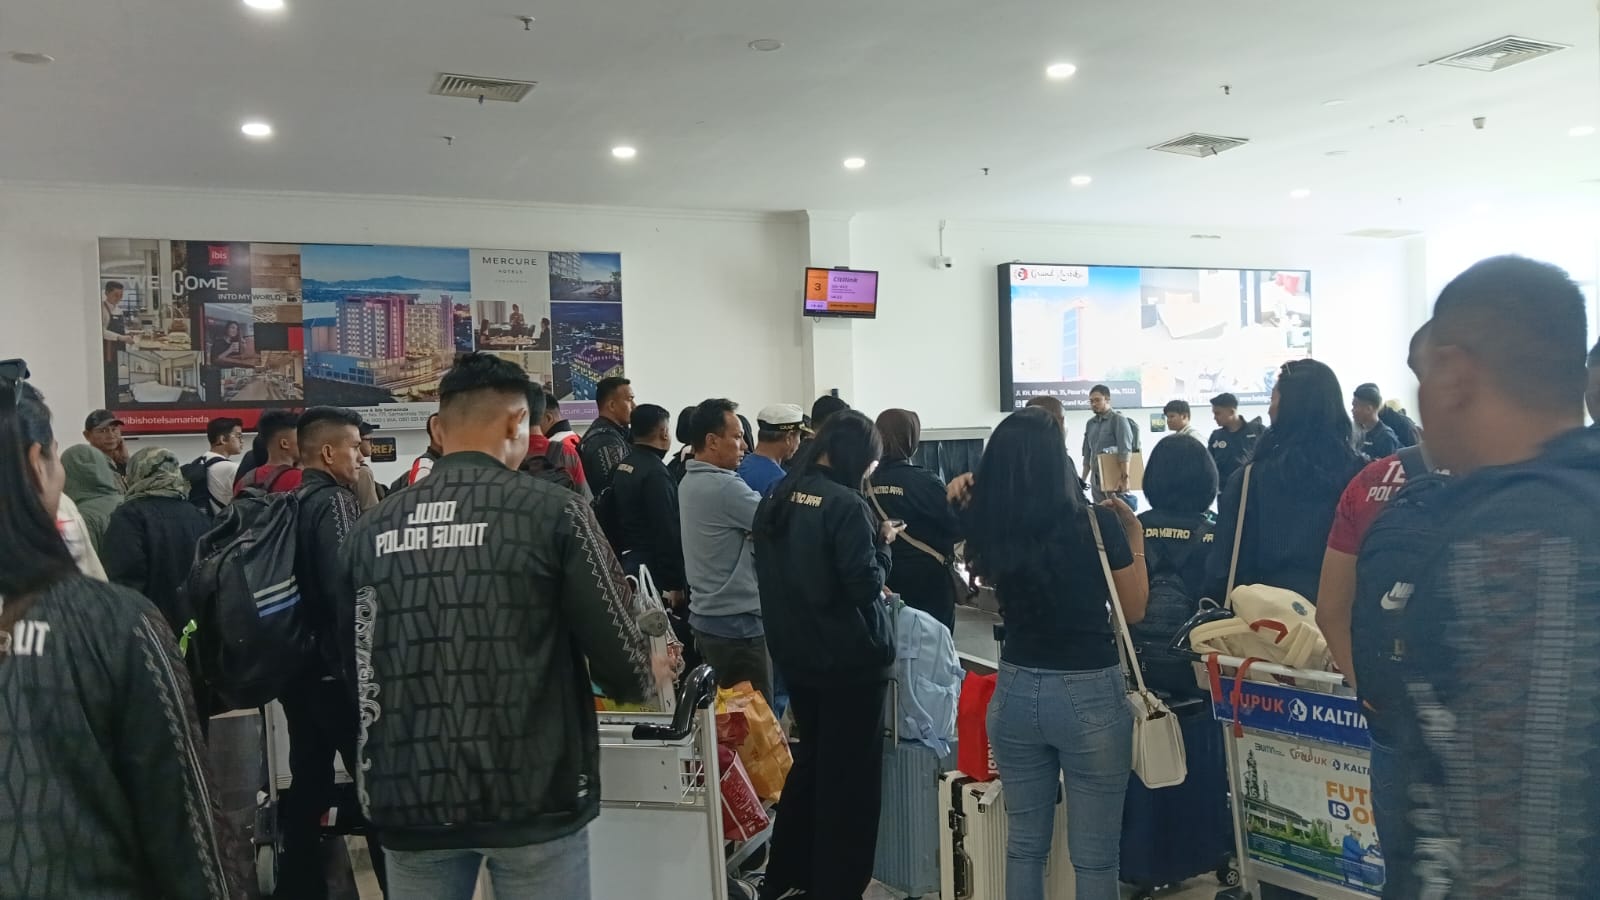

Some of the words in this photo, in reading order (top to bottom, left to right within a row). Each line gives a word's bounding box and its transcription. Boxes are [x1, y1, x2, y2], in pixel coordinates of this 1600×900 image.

[211, 251, 228, 260] ibis
[482, 256, 537, 266] MERCURE
[814, 282, 822, 291] 3
[408, 501, 457, 525] JUDO
[376, 527, 428, 557] POLDA
[432, 523, 488, 549] SUMUT
[1160, 527, 1191, 539] METRO
[1326, 780, 1370, 806] FUT
[1332, 802, 1348, 818] IS
